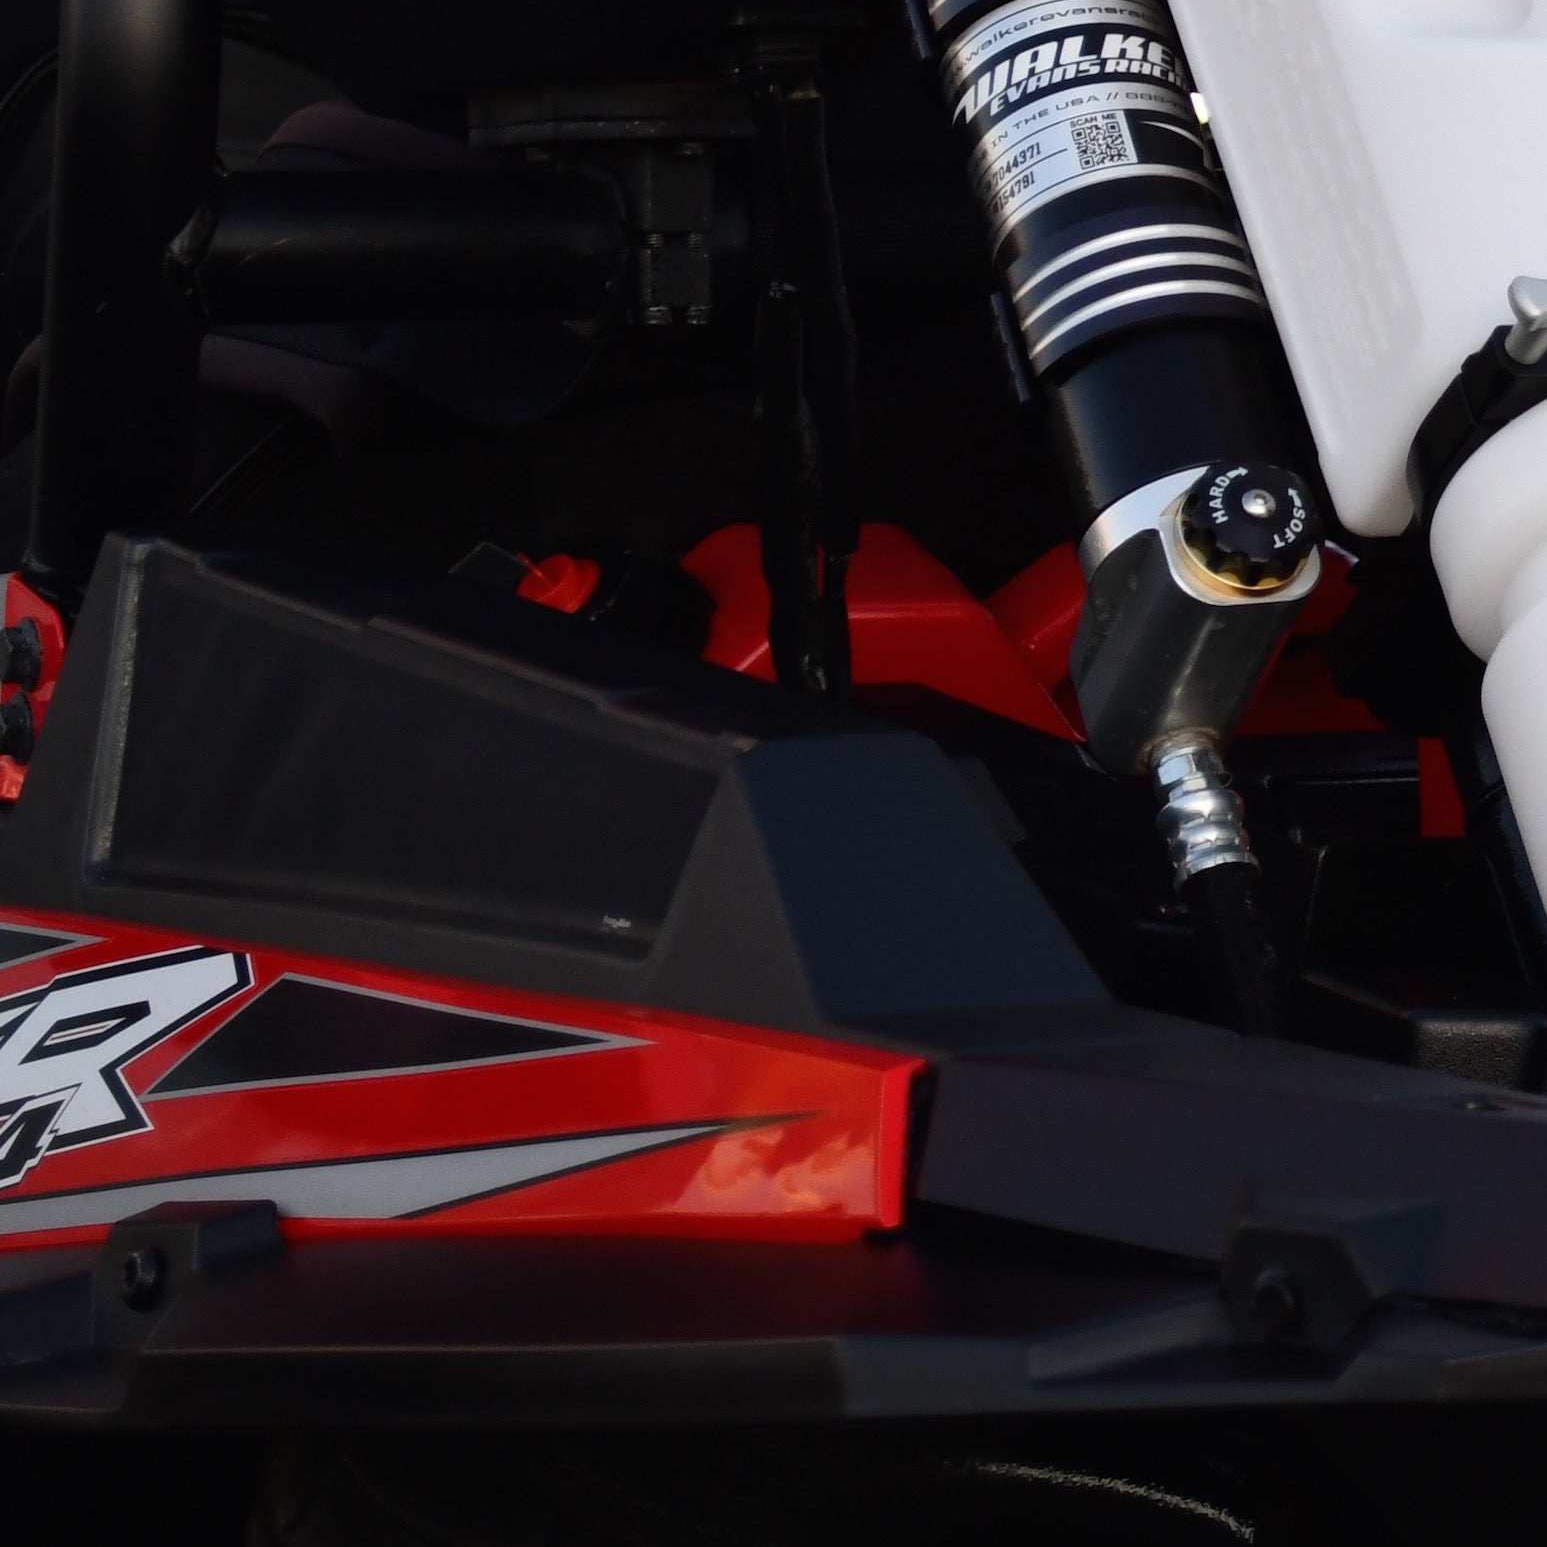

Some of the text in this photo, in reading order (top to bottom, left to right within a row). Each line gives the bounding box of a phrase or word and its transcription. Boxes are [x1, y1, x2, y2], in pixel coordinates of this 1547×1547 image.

[989, 58, 1101, 116] EVANS
[1012, 106, 1049, 131] THE
[1055, 94, 1100, 110] USA
[1069, 112, 1117, 128] SCAN ME
[1208, 476, 1231, 524] HARD
[1272, 507, 1306, 550] SOFT
